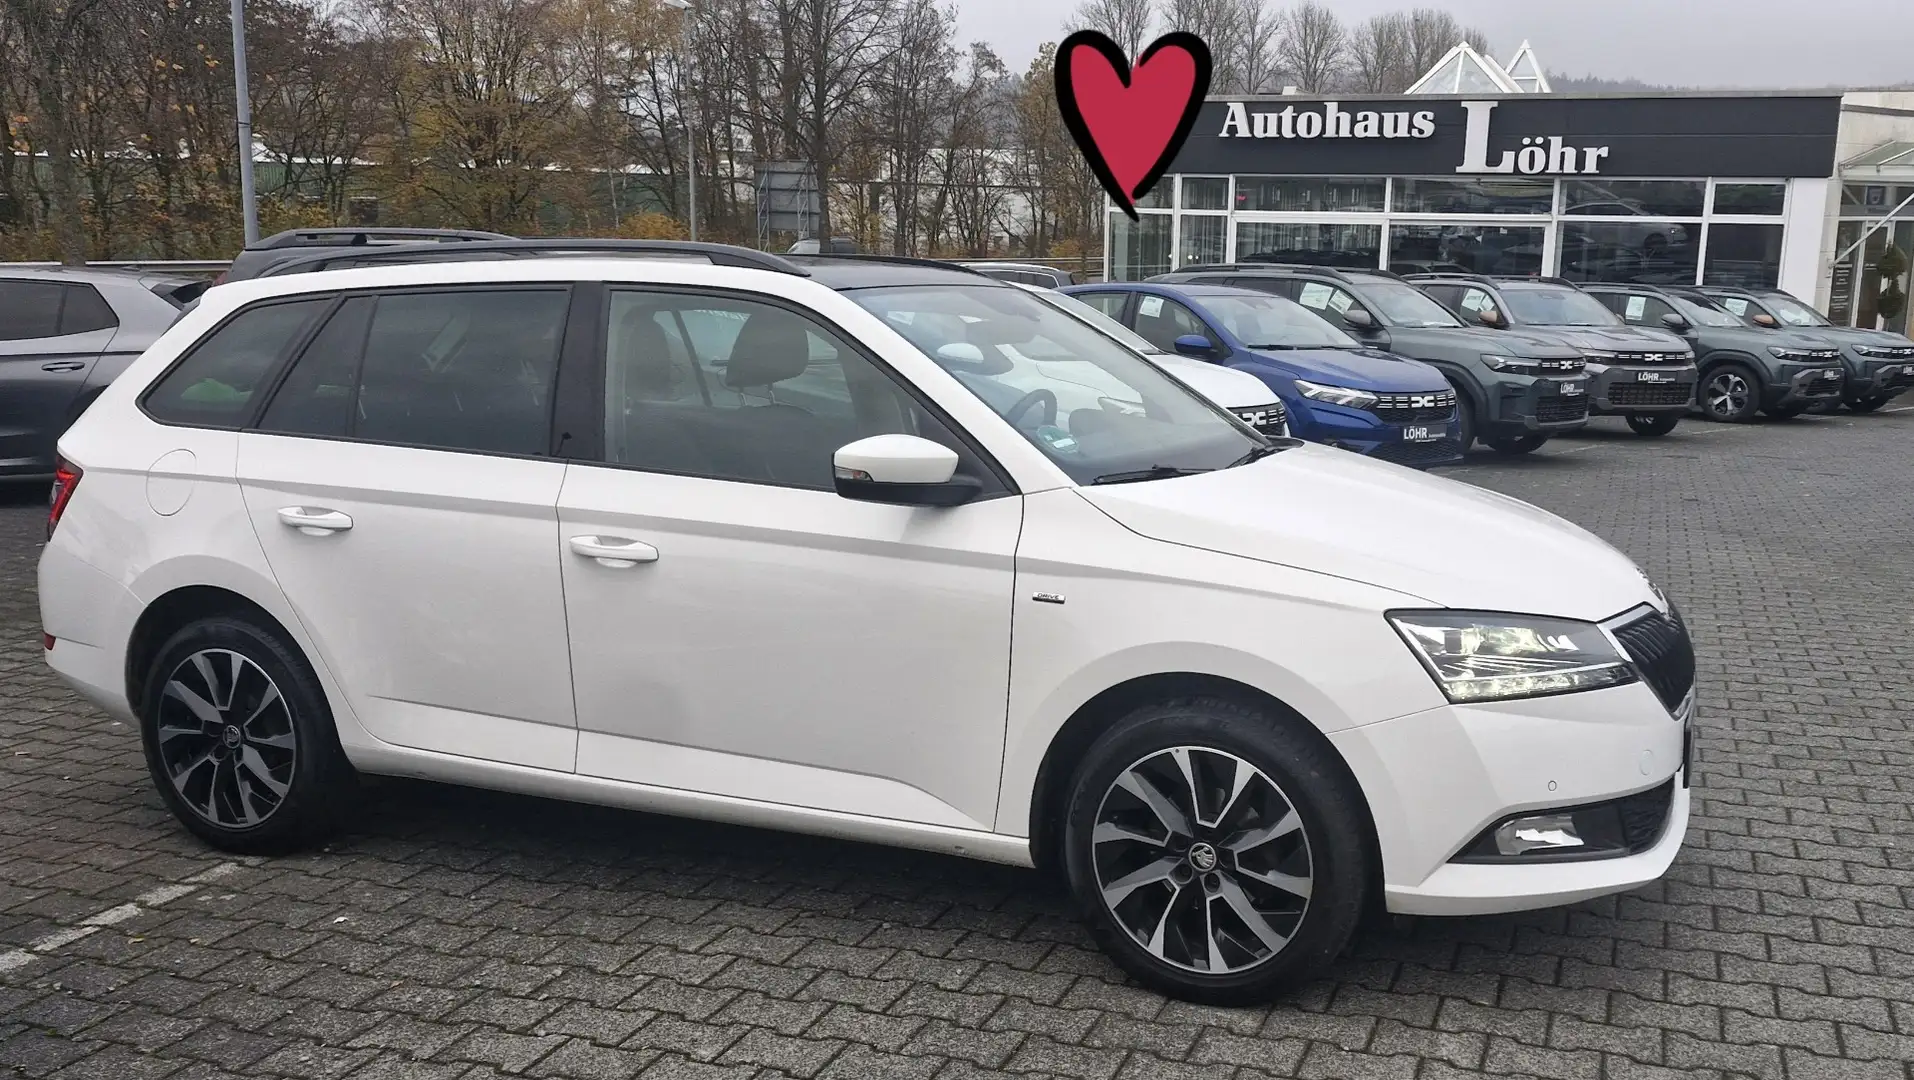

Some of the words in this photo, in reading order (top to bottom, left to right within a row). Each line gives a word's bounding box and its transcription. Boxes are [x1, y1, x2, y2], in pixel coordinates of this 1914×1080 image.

[1219, 102, 1436, 139] Autohaus
[1456, 101, 1609, 174] Löhr
[1403, 425, 1428, 440] LÖHR
